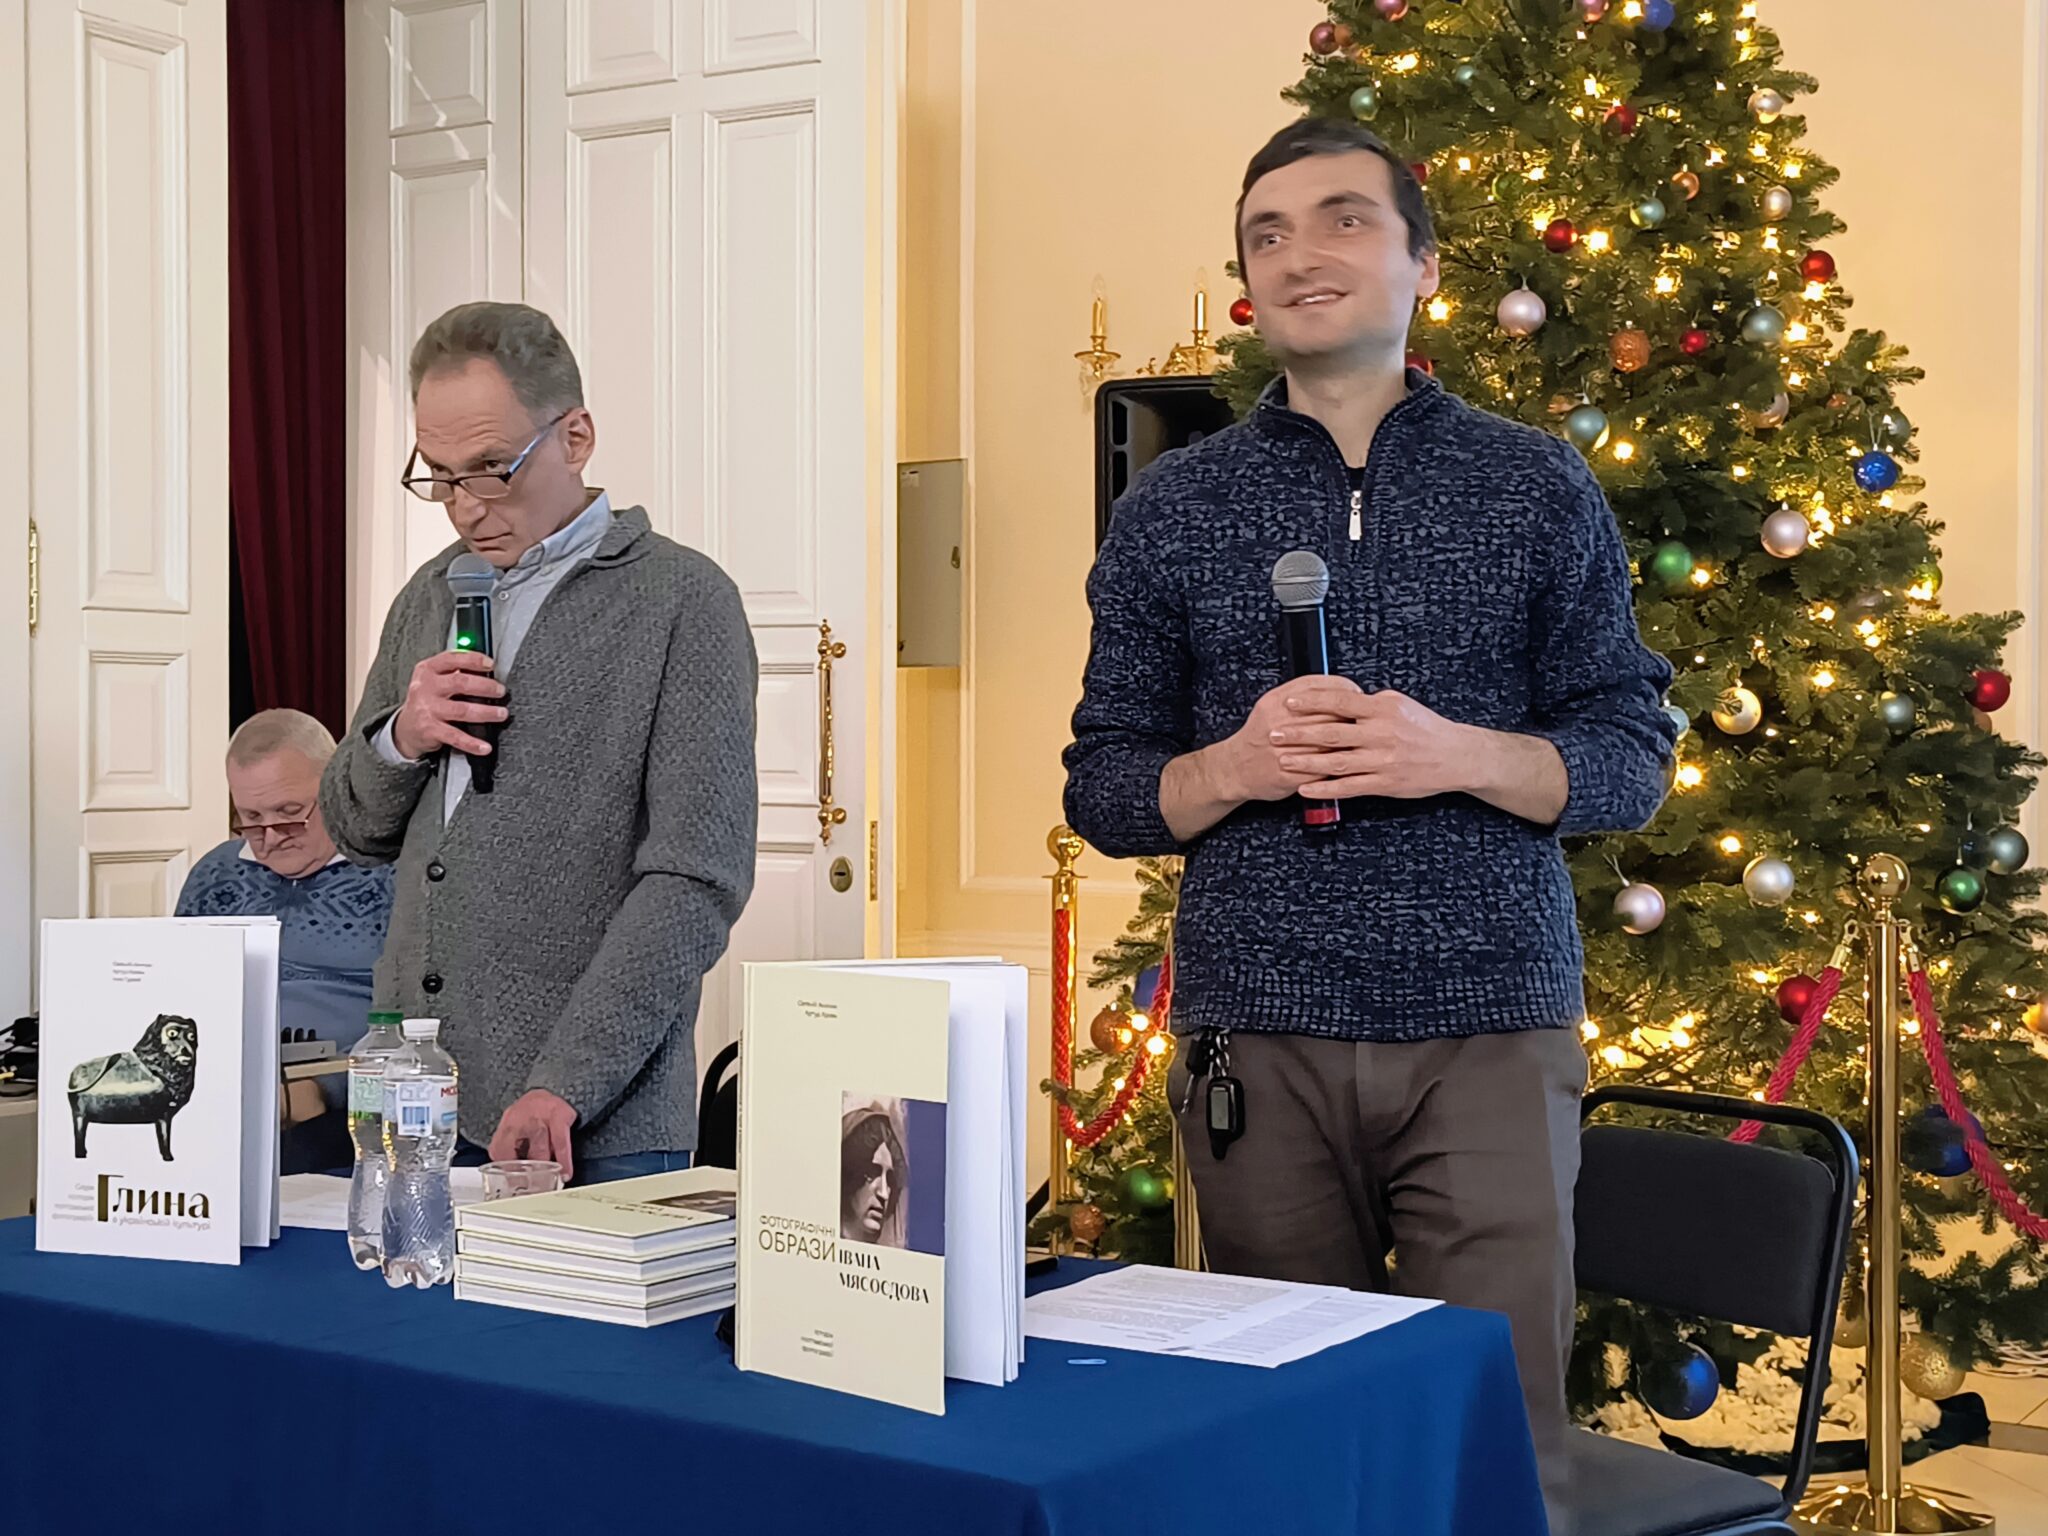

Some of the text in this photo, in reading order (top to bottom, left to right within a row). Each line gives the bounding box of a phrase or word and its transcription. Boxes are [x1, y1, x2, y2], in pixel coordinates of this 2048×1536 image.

[97, 1174, 210, 1222] Глина
[759, 1215, 836, 1237] ФОТОГРАФІЧНІ
[758, 1229, 880, 1271] ОБРАЗИ ІВАНА
